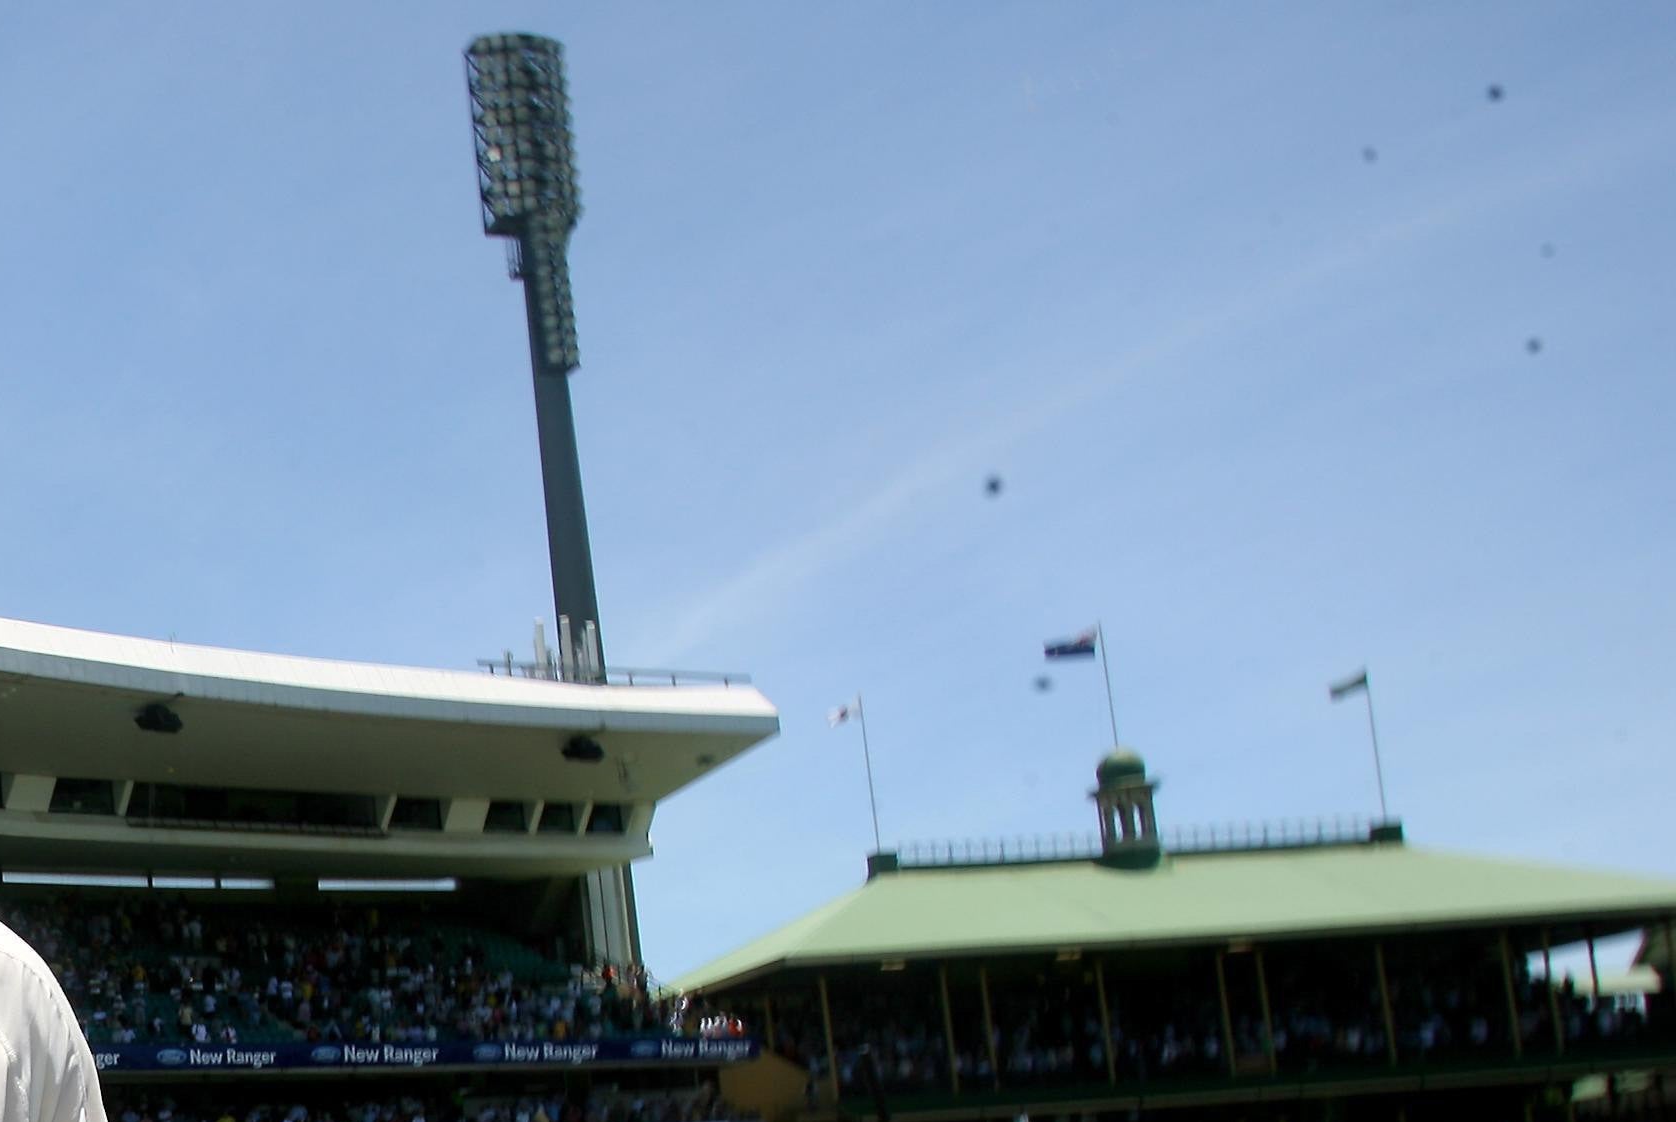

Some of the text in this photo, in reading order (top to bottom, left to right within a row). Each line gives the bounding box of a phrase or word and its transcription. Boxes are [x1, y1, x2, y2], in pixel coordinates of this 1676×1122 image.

[189, 1048, 223, 1065] New
[226, 1048, 277, 1069] Ranger
[343, 1045, 380, 1063] New
[383, 1045, 439, 1067] Ranger
[504, 1043, 540, 1061] New
[543, 1043, 599, 1065] Ranger
